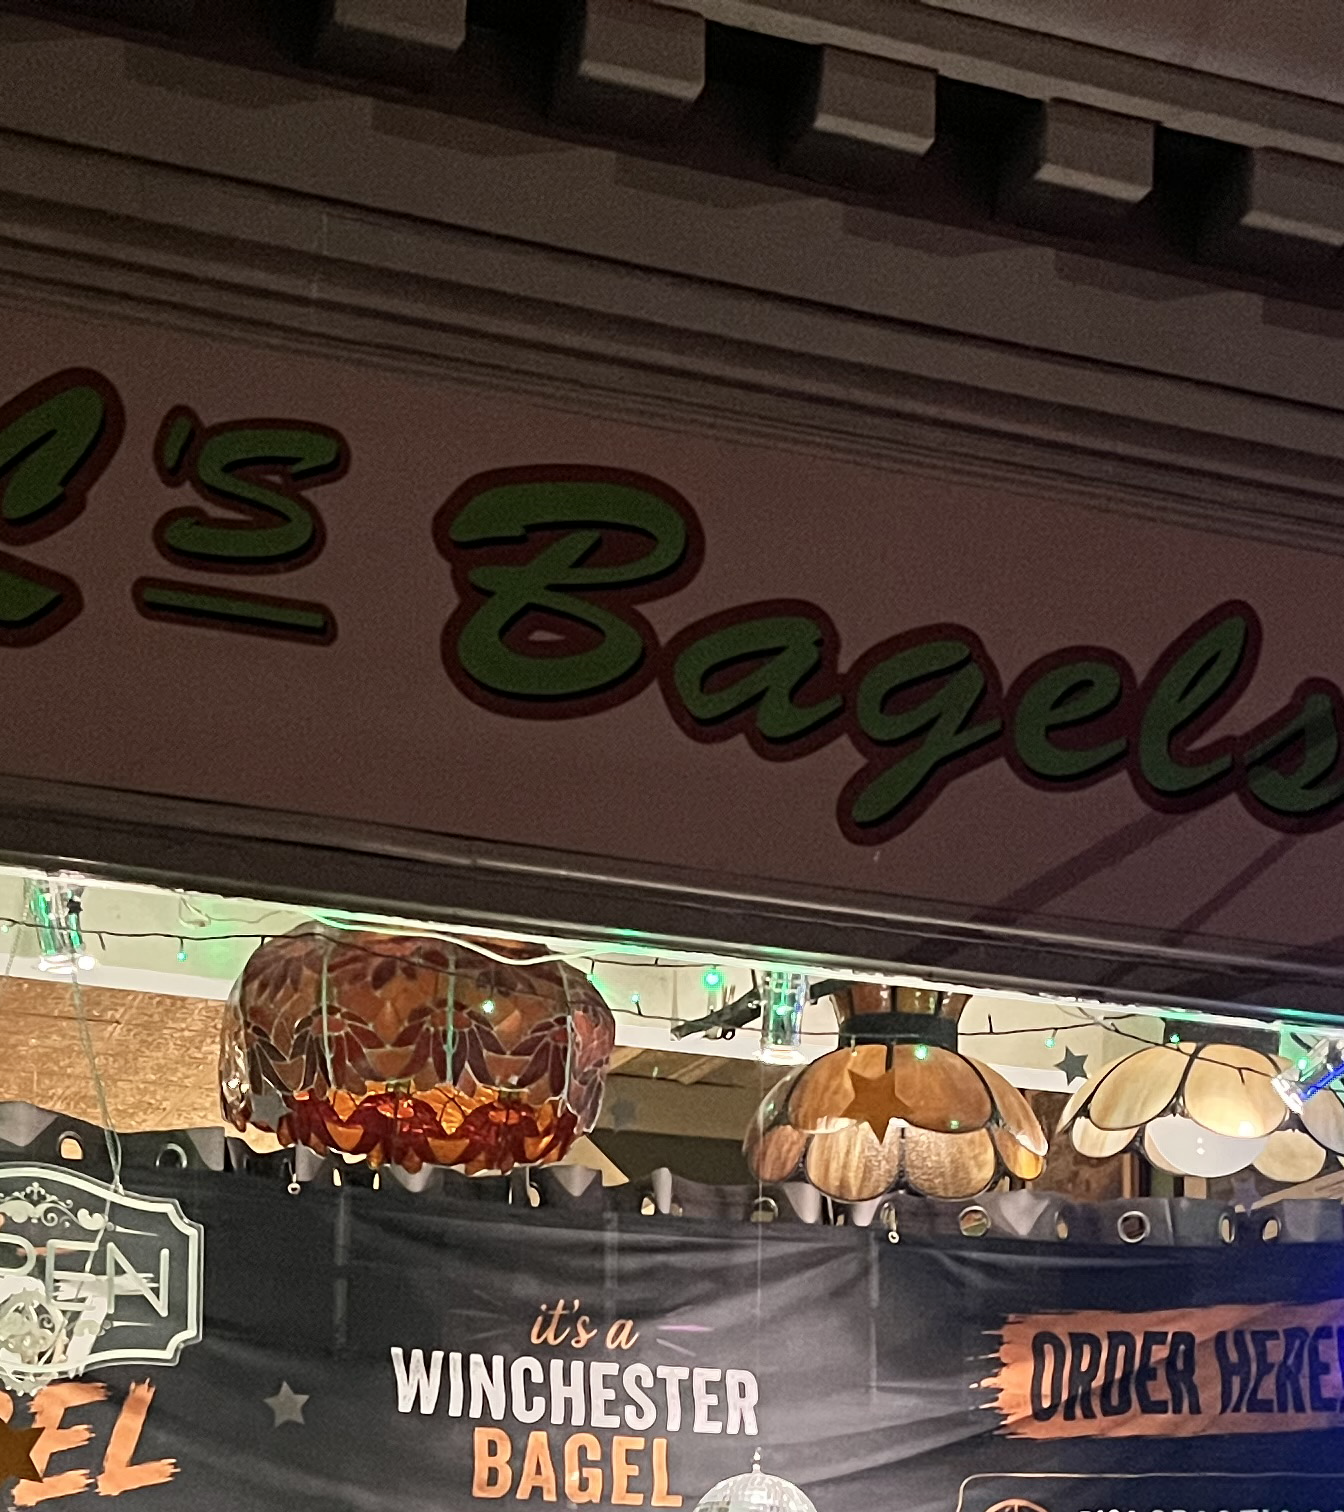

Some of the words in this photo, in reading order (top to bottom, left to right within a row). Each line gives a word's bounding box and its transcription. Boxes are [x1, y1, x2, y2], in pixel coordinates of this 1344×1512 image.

[531, 1299, 598, 1348] it's
[605, 1318, 640, 1351] a
[390, 1346, 759, 1436] WINCHESTER
[1030, 1330, 1202, 1422] ORDER
[472, 1427, 683, 1508] BAGEL
